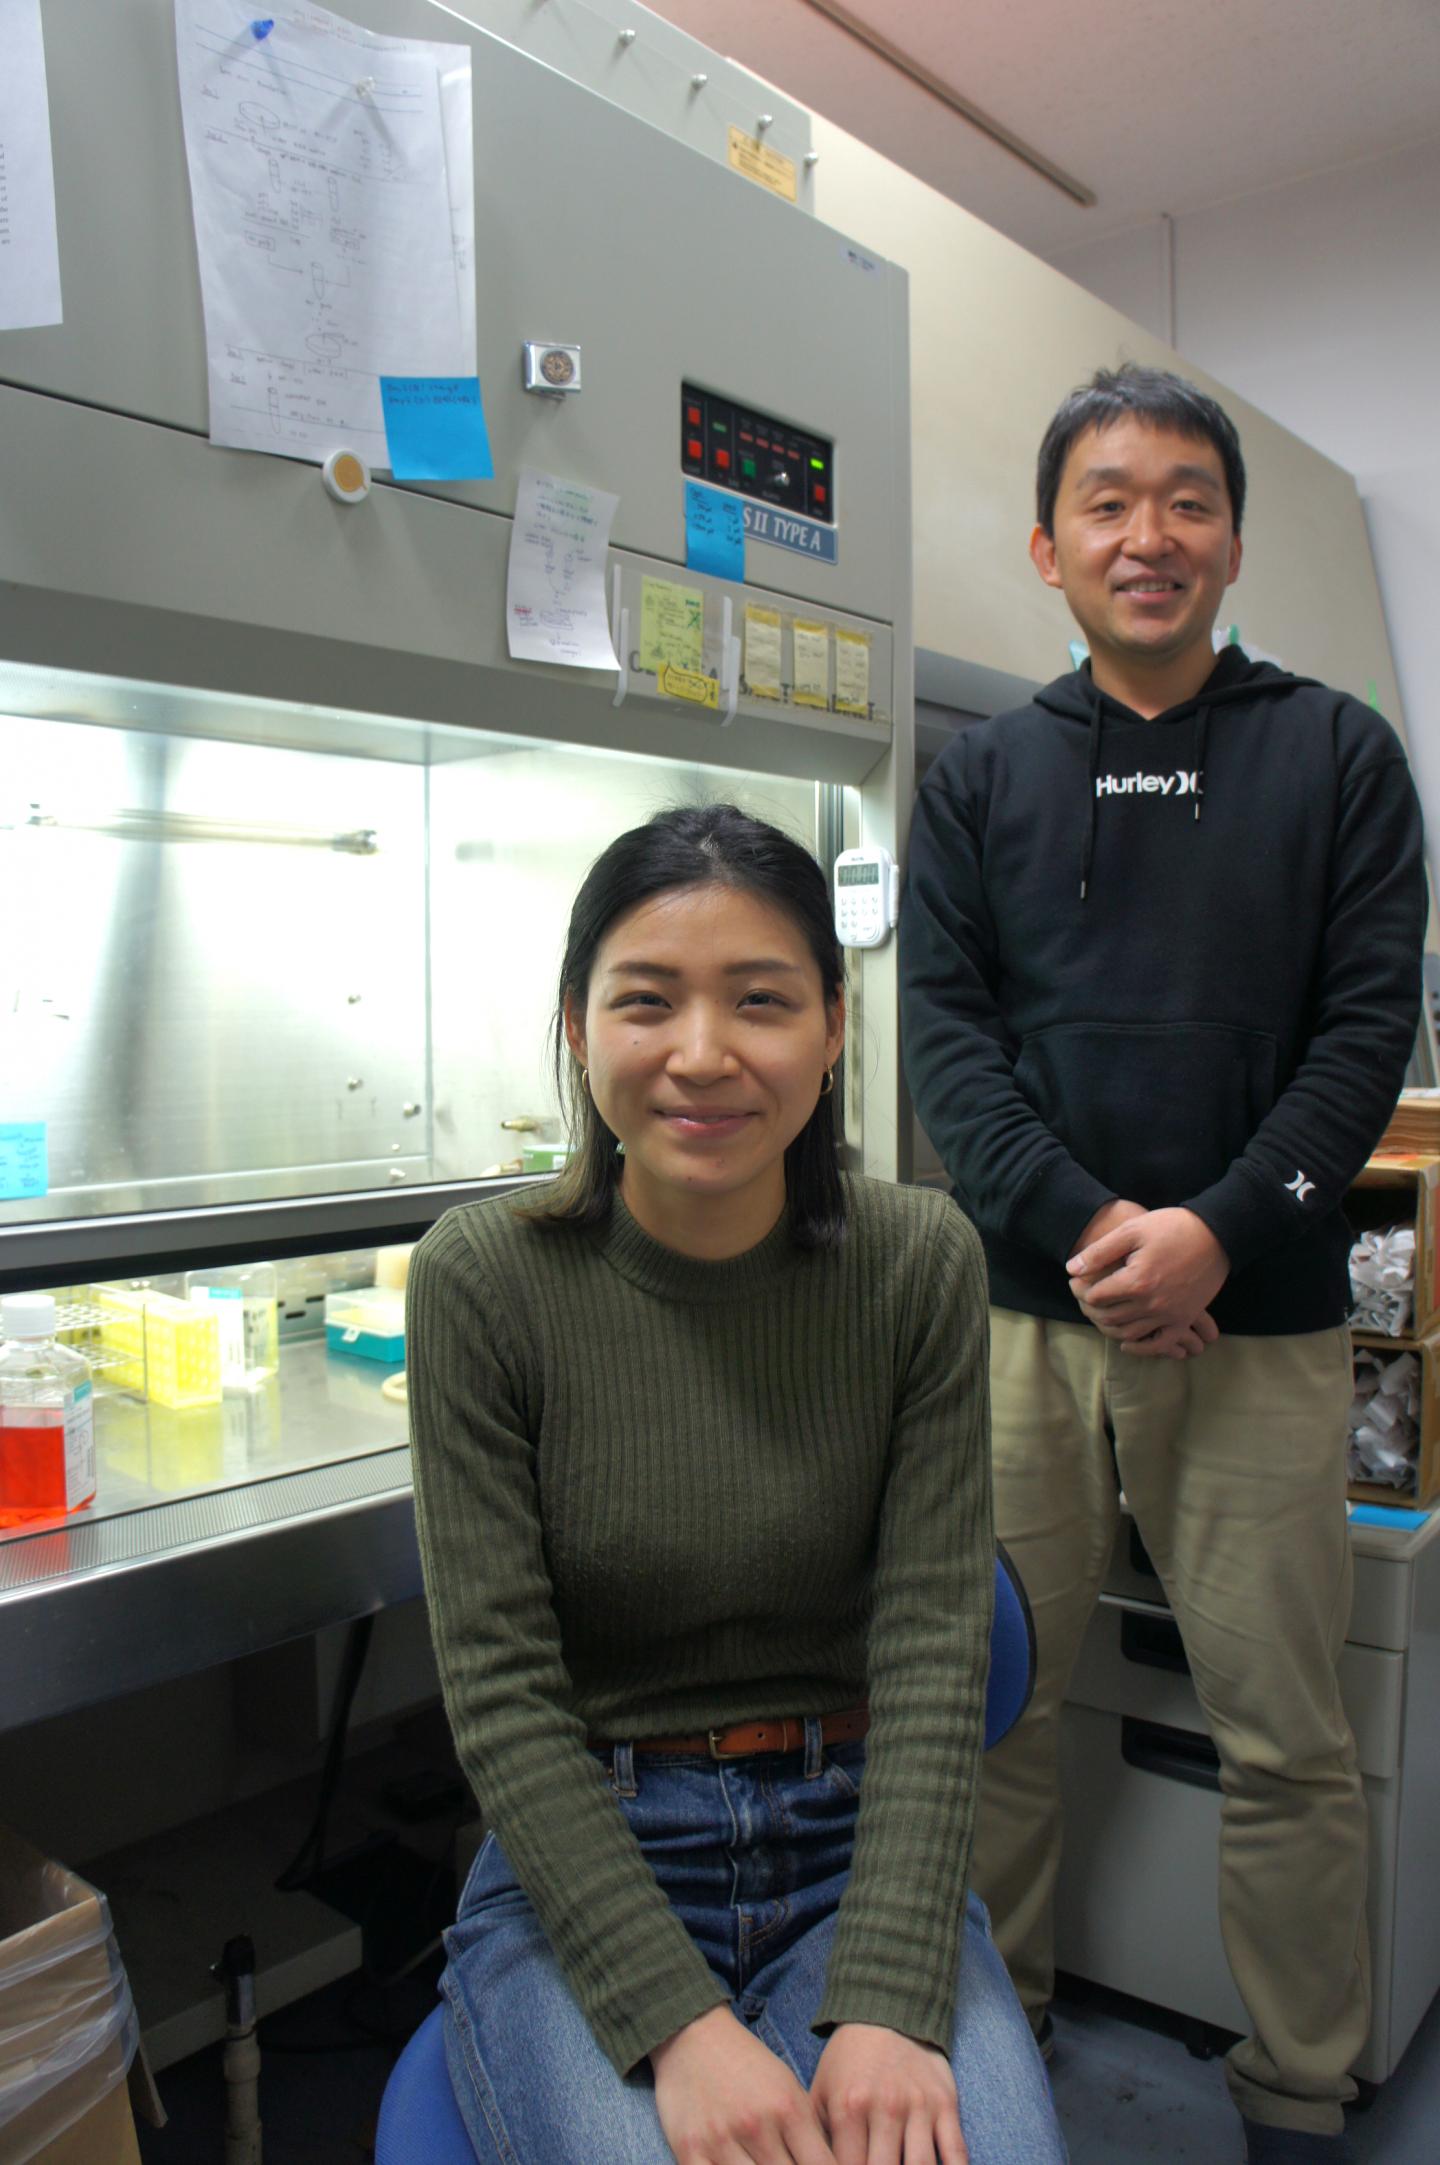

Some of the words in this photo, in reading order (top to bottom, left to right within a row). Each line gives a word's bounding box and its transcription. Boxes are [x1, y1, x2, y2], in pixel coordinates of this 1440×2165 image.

[743, 506, 753, 527] S
[753, 511, 769, 534] II
[774, 517, 808, 547] TYPE
[810, 531, 821, 552] A
[1096, 771, 1176, 798] Hurley
